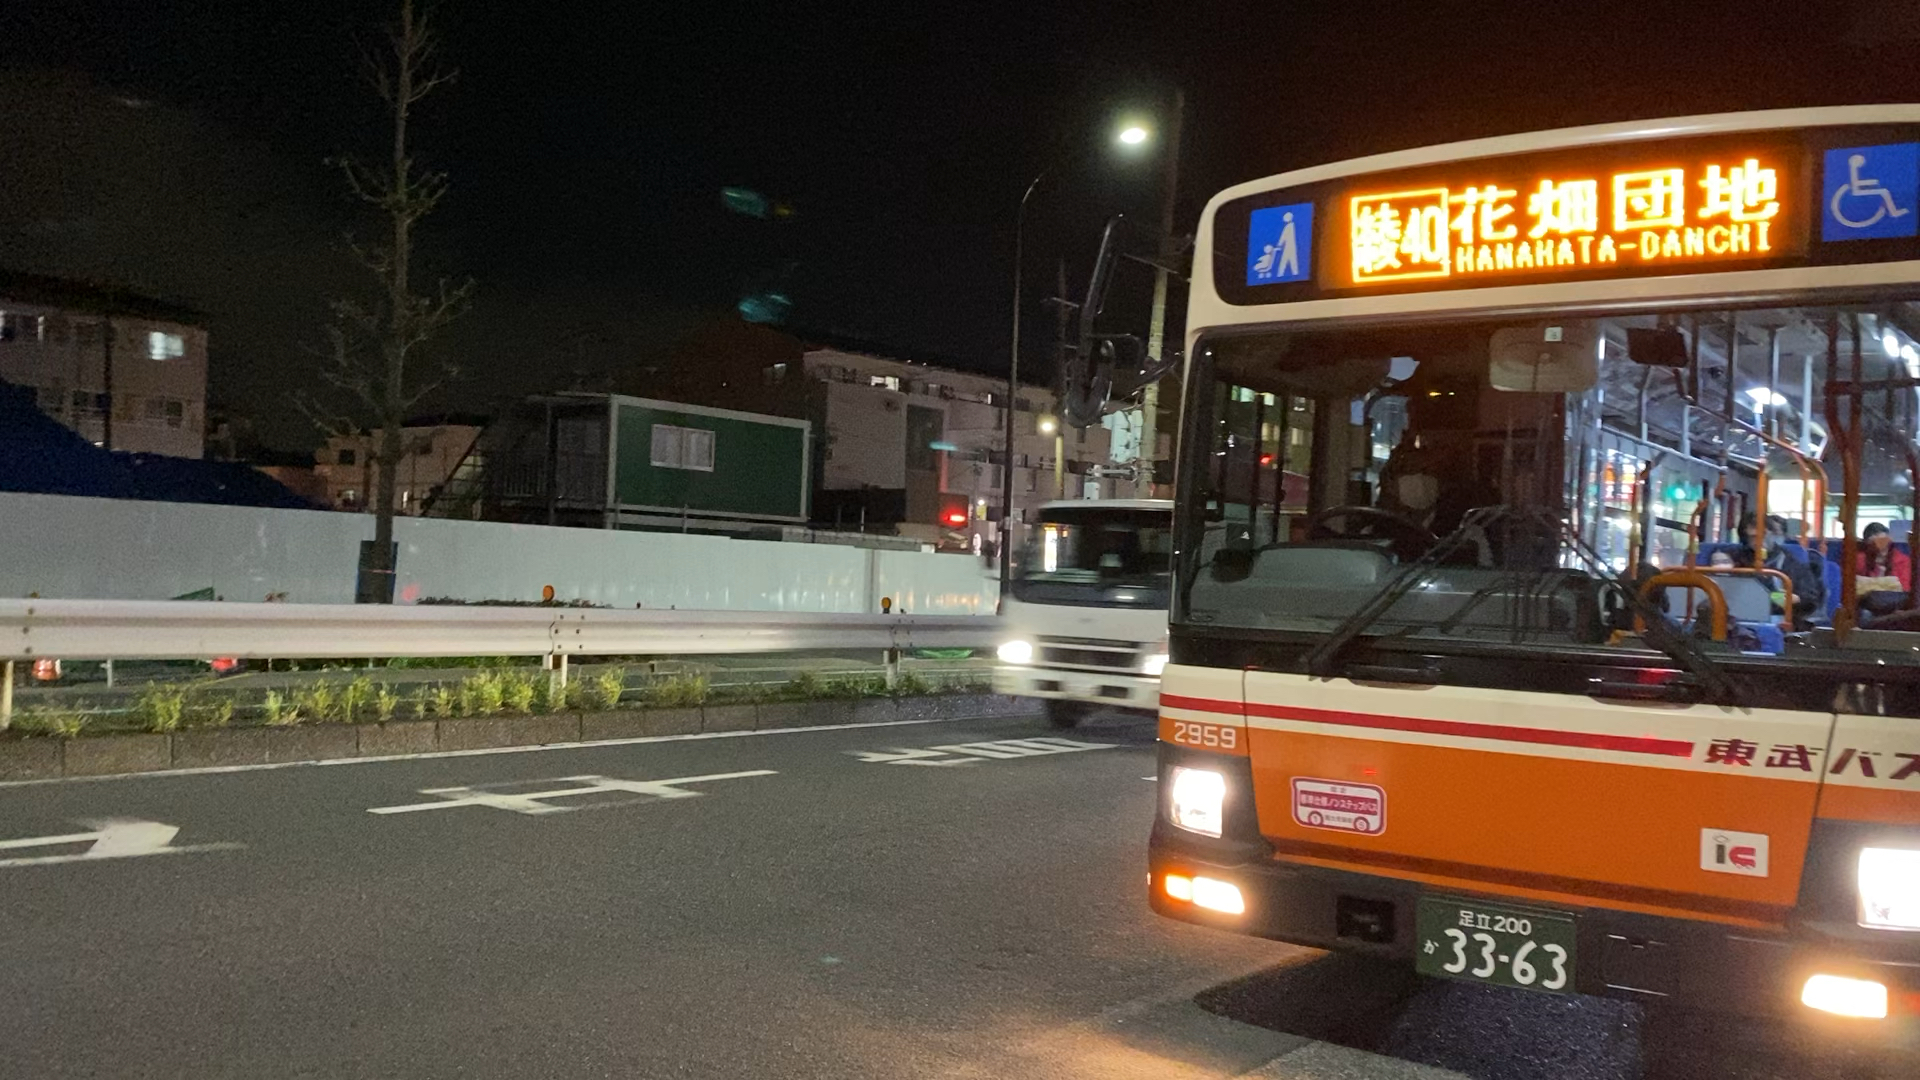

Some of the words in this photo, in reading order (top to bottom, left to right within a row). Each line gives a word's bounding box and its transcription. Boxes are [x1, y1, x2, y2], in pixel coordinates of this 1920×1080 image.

[1449, 159, 1781, 244] 花畑団地
[1456, 221, 1771, 272] HANAHATA-DANCHI
[1174, 722, 1236, 749] 2959
[1423, 939, 1440, 955] か
[1442, 928, 1568, 990] 33-63
